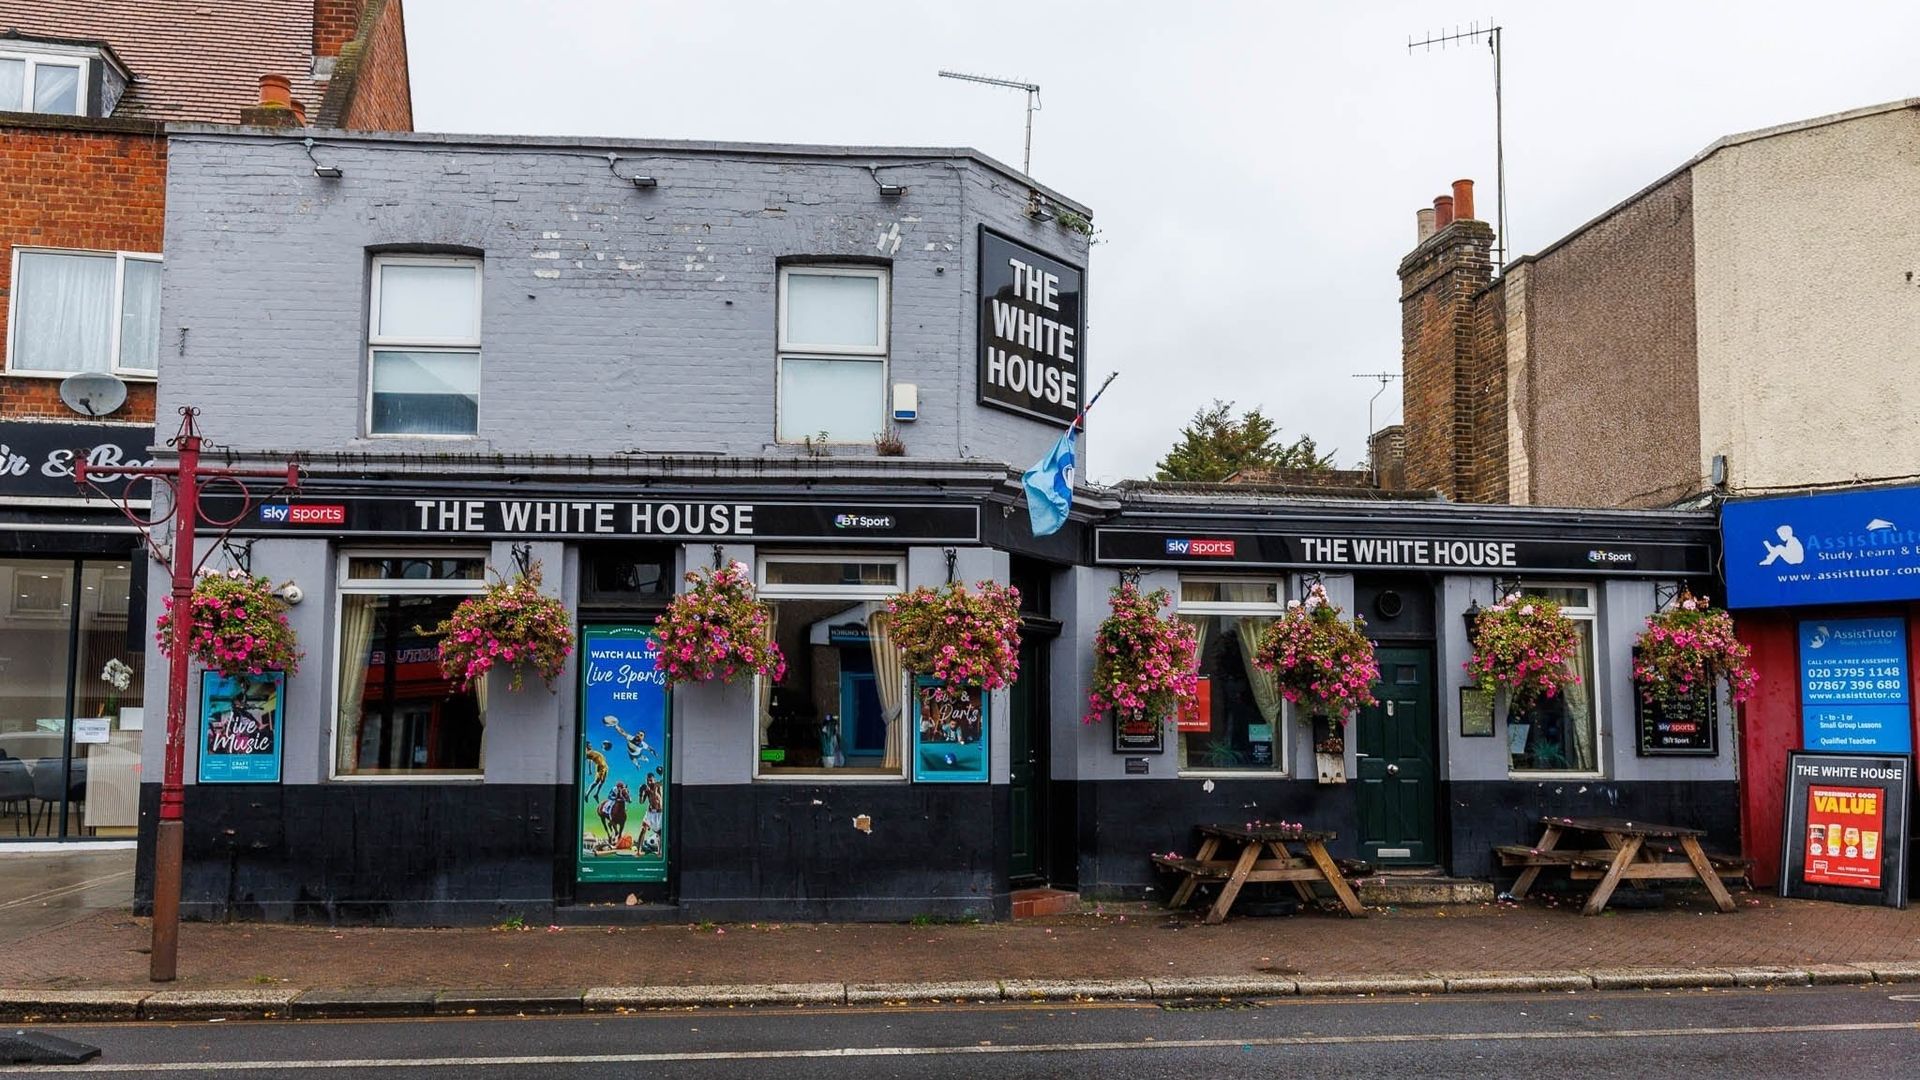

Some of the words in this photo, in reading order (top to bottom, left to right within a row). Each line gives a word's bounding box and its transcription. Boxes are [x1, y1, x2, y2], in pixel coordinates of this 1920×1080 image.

[1009, 258, 1059, 311] THE
[993, 299, 1074, 363] WHITE
[988, 346, 1076, 409] HOUSE
[41, 450, 76, 478] &
[263, 505, 288, 521] sky
[293, 506, 342, 521] sports
[415, 501, 485, 531] THE
[500, 502, 615, 533] WHITE
[631, 504, 754, 535] HOUSE
[841, 516, 859, 526] BT
[860, 516, 889, 528] Sport
[1807, 528, 1920, 550] AssistTut
[1168, 541, 1188, 554] sky
[1192, 541, 1232, 555] sports
[1300, 538, 1348, 562] THE
[1352, 539, 1429, 564] WHITE
[1434, 541, 1517, 566] HOUSE
[1901, 546, 1910, 555] &
[1593, 551, 1607, 561] BT
[1608, 552, 1632, 562] Sport
[1834, 629, 1898, 639] AssistTutor
[591, 651, 623, 659] WATCH
[625, 651, 642, 659] ALL
[586, 661, 613, 687] Live
[1808, 668, 1831, 678] 020
[1834, 667, 1865, 678] 3795
[1868, 667, 1900, 677] 1148
[1808, 681, 1846, 691] 07867
[1850, 680, 1873, 690] 396
[1877, 680, 1900, 690] 680
[613, 692, 638, 700] HERE
[961, 690, 970, 702] &
[940, 703, 979, 724] Darts
[1659, 723, 1671, 731] sky
[1672, 723, 1695, 732] sports
[1837, 722, 1857, 730] Group
[213, 732, 270, 754] Music
[1821, 737, 1847, 746] Qualified
[1797, 765, 1819, 776] THE
[1821, 766, 1858, 778] WHITE
[1860, 767, 1902, 780] HOUSE
[1814, 796, 1877, 815] VALUE
